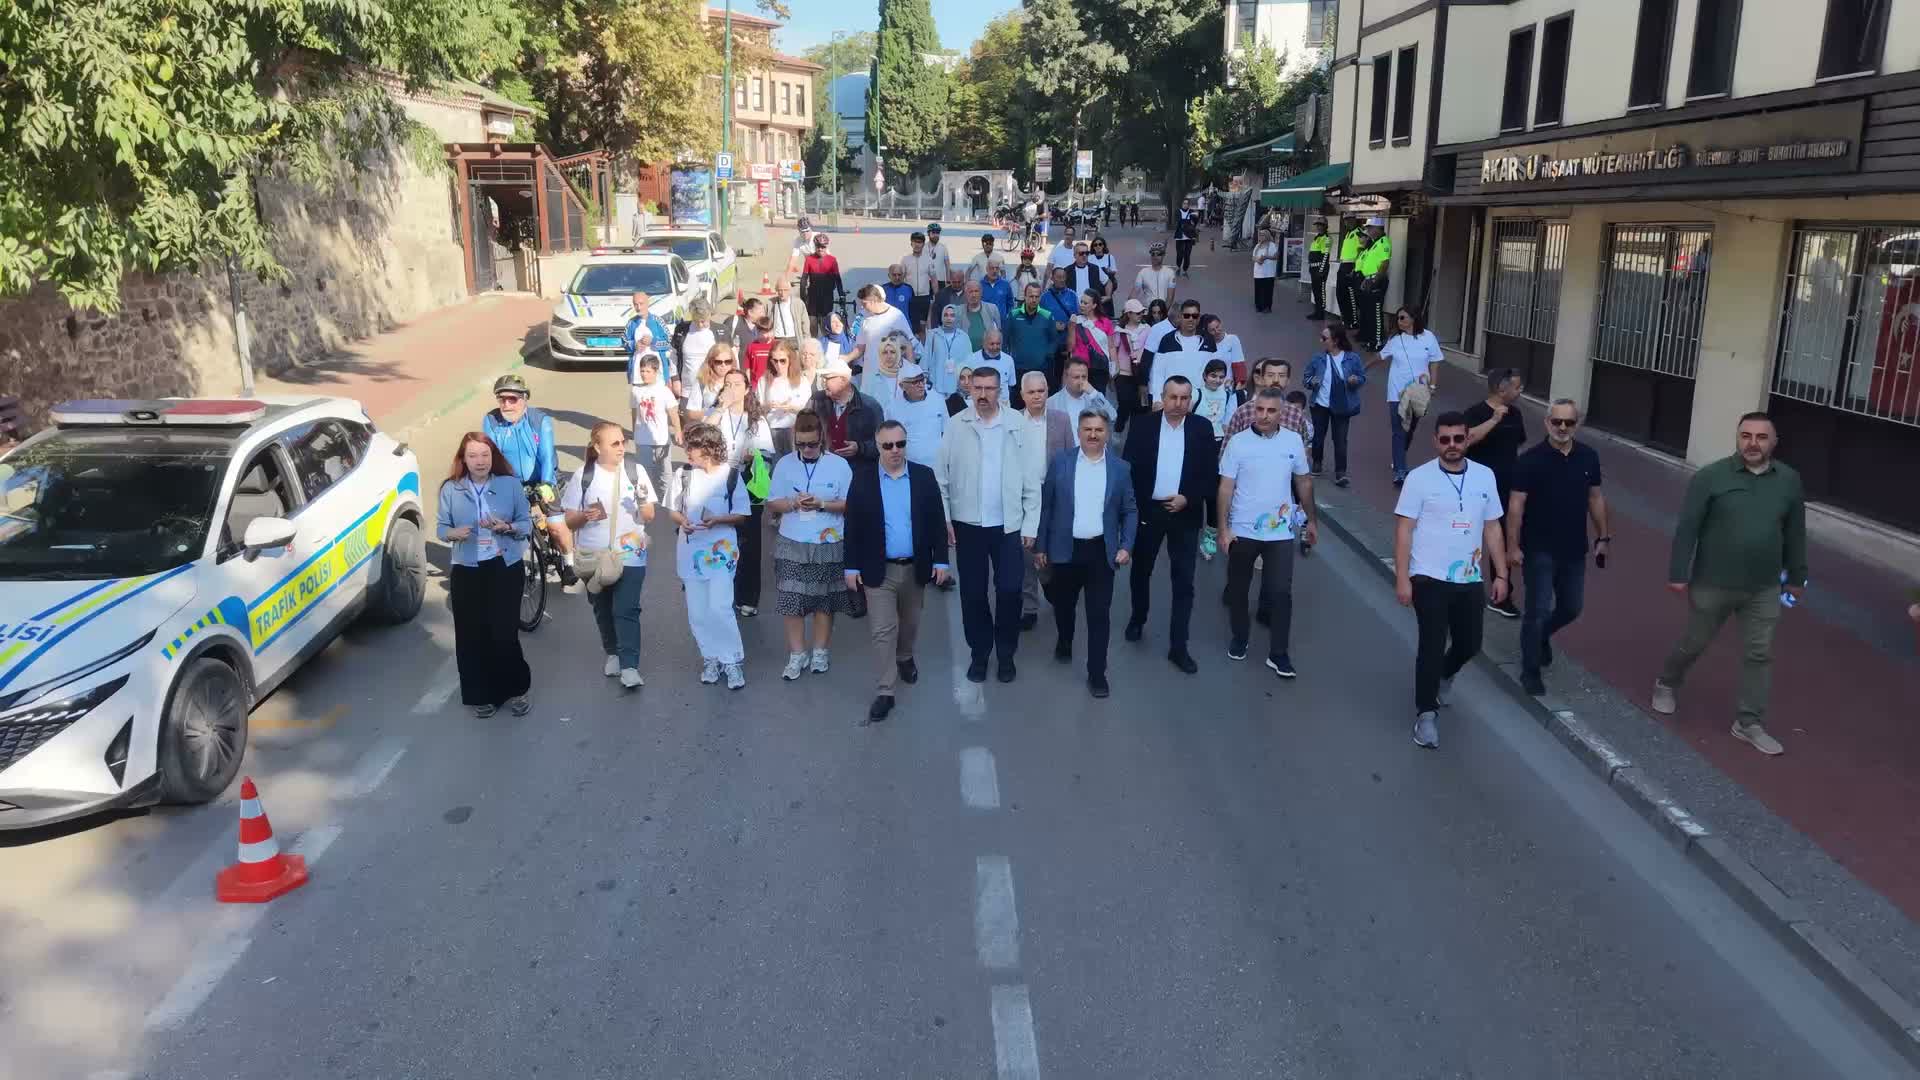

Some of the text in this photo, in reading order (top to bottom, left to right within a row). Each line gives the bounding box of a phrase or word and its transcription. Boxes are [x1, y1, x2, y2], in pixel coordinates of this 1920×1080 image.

[720, 156, 729, 167] D
[1481, 155, 1538, 183] AKARSU
[255, 558, 332, 636] TRAFİK POLİSİ
